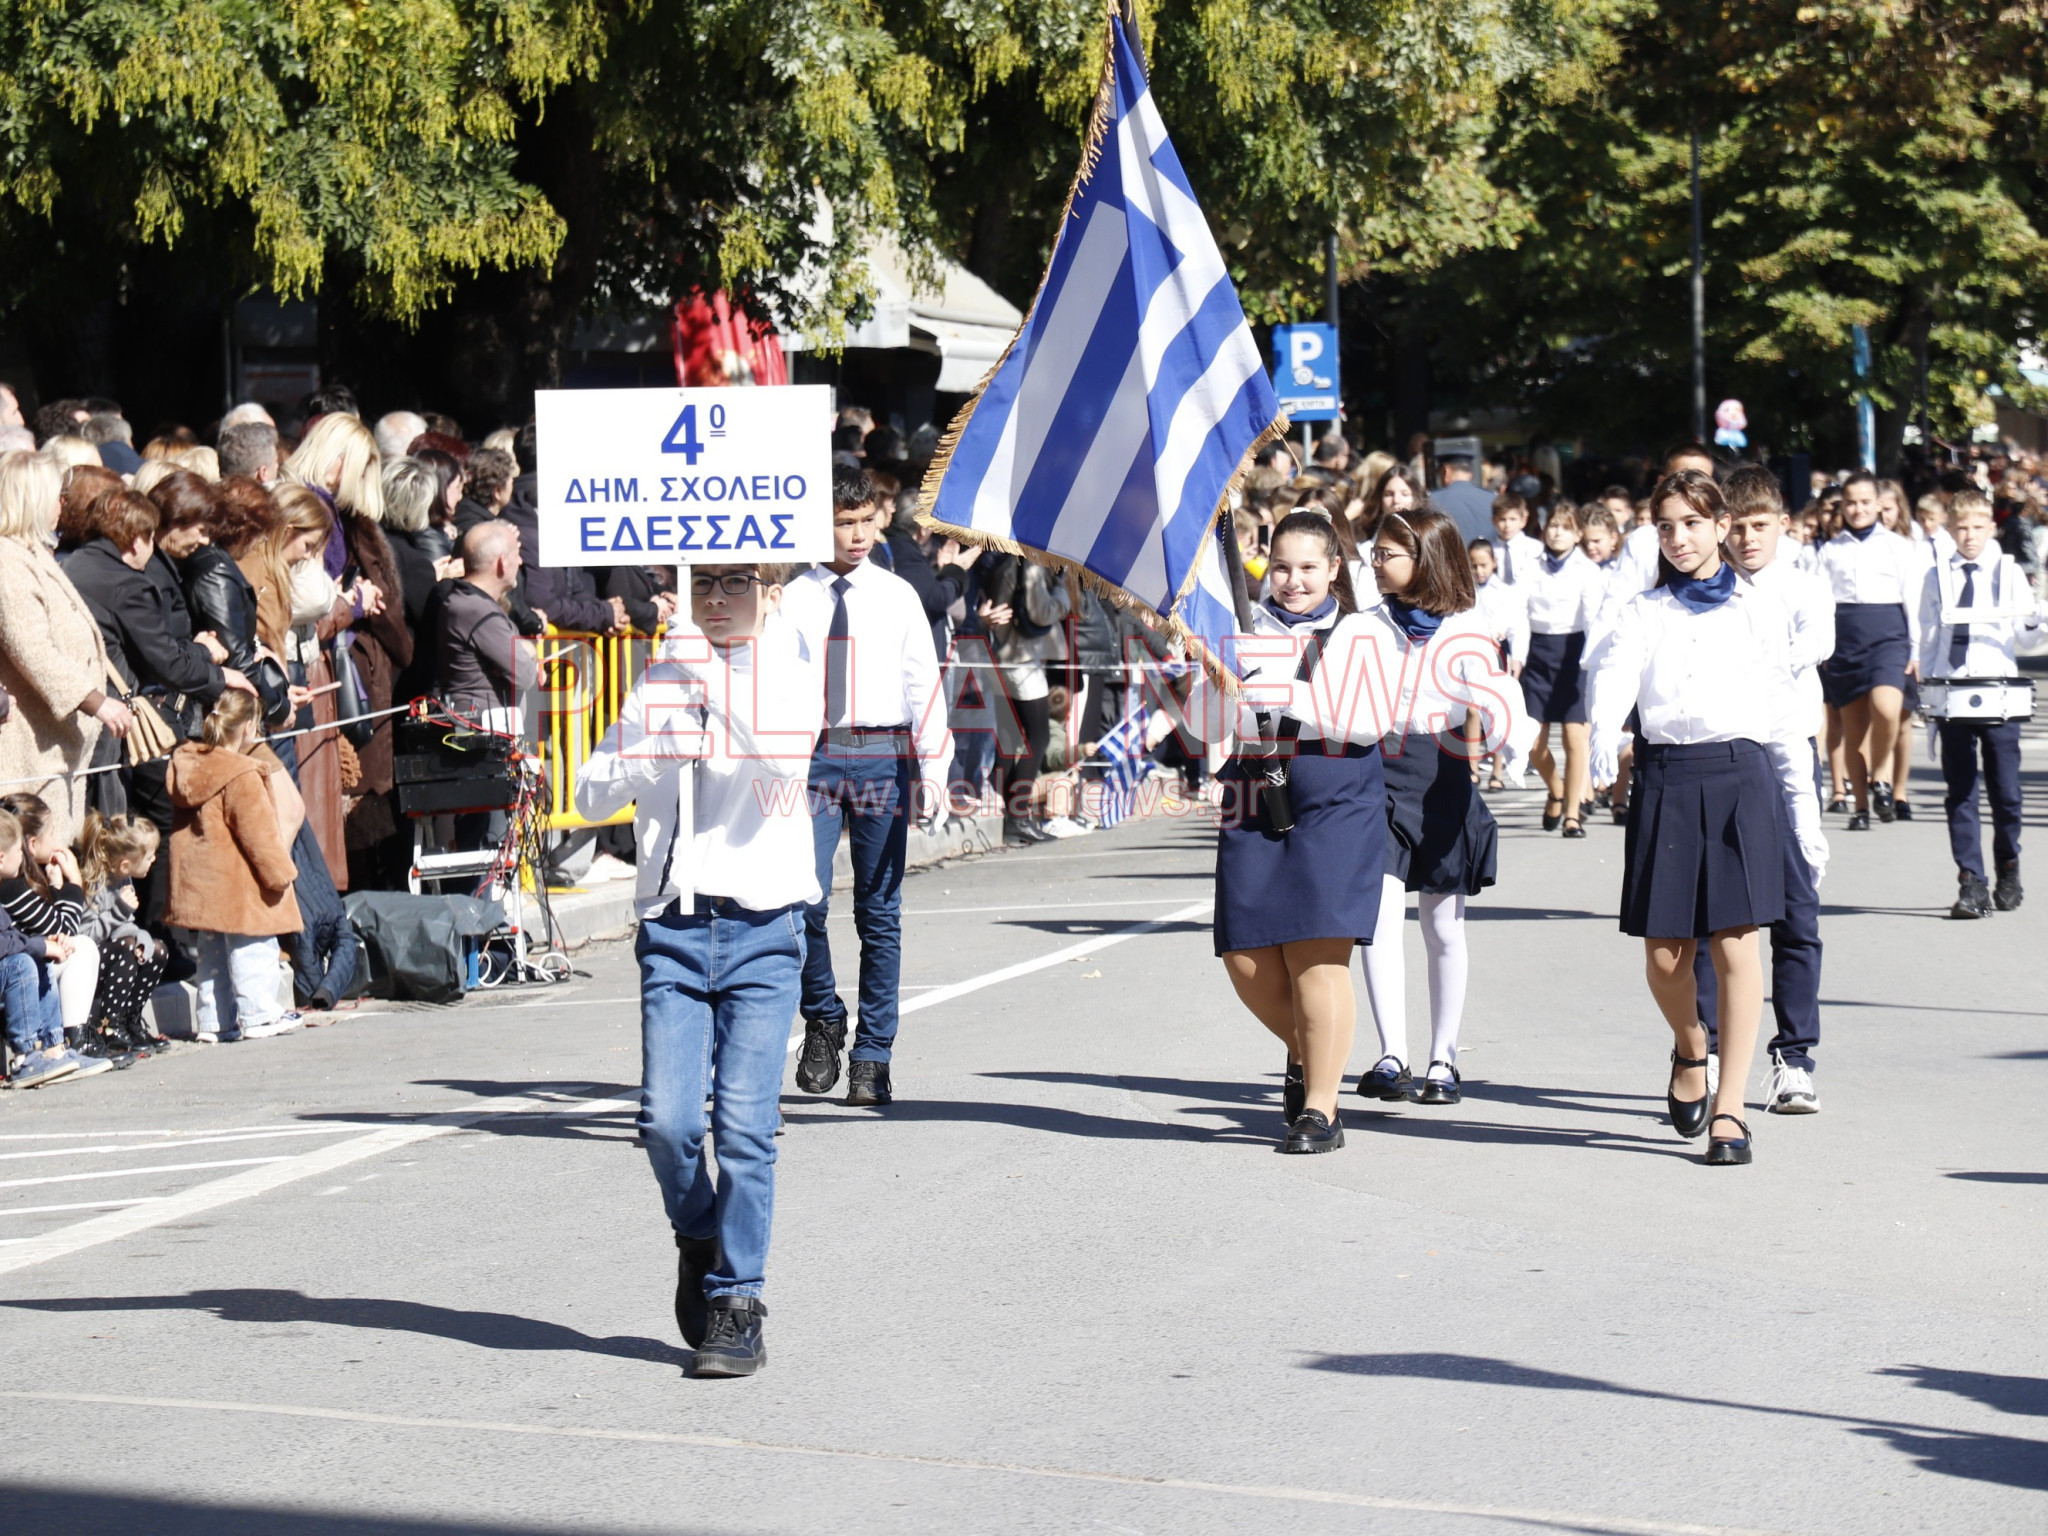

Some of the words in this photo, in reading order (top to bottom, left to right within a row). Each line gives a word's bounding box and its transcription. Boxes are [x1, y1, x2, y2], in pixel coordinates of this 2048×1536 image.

[1290, 331, 1323, 374] P
[564, 477, 649, 503] ΔΗΜ.
[660, 474, 807, 501] ΣΧΟΛΕΙΟ
[580, 514, 796, 551] ΕΔΕΣΣΑΣ
